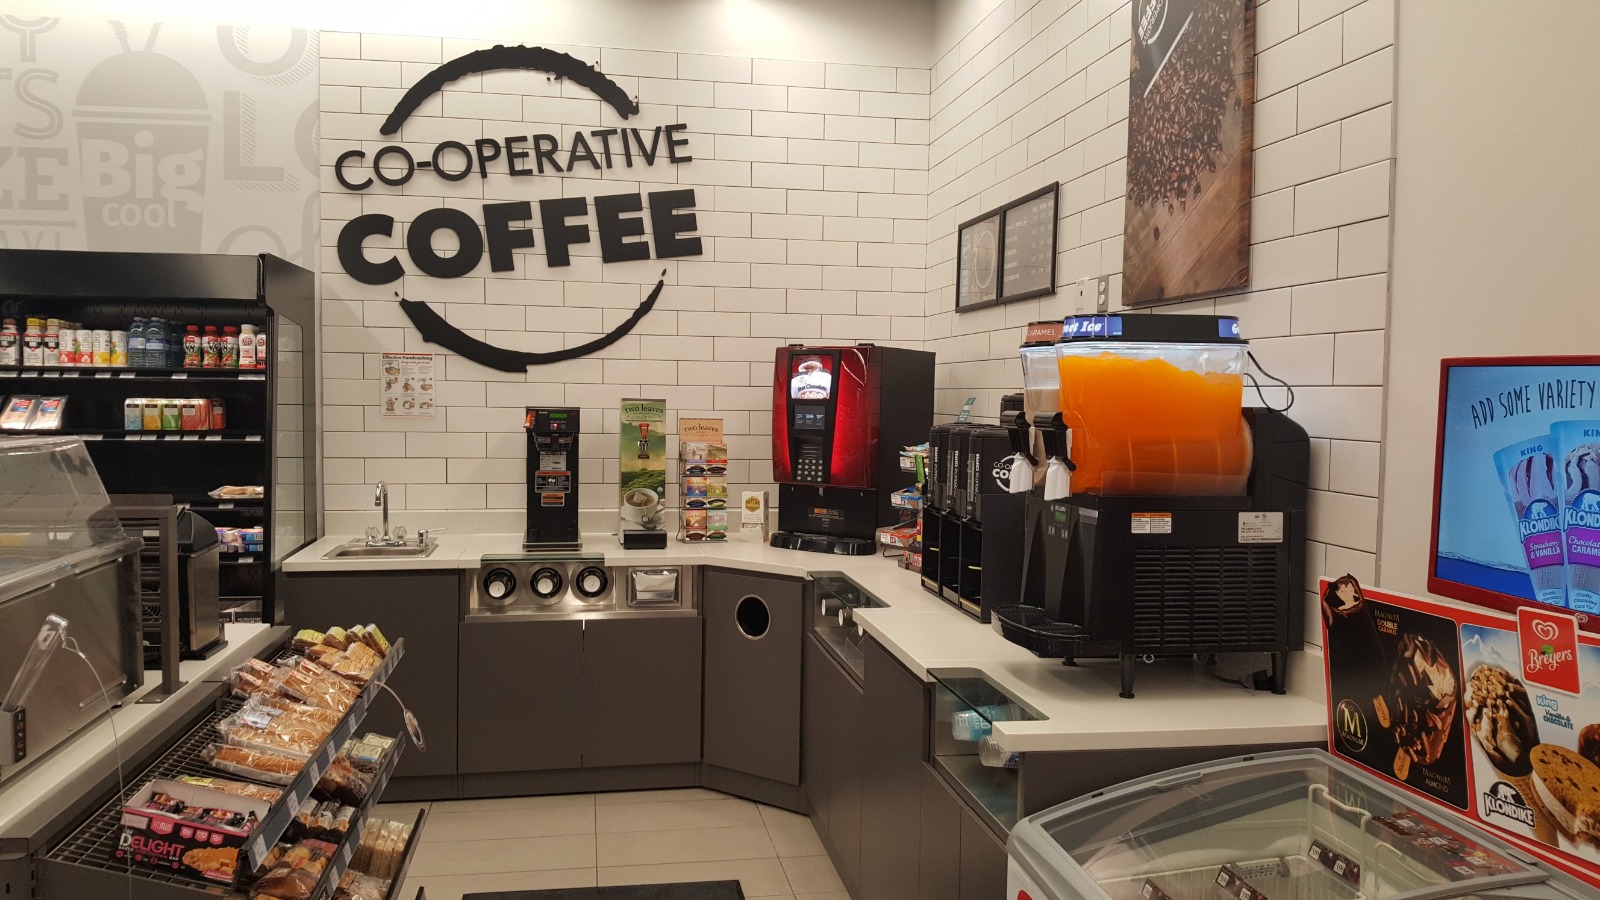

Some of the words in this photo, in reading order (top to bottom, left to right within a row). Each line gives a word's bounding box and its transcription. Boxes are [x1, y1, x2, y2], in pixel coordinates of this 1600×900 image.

[335, 123, 693, 191] CO-OPERATIVE
[81, 130, 206, 214] Big
[102, 199, 177, 228] cool
[337, 188, 703, 285] COFFEE
[1027, 328, 1057, 337] CARAMEL
[1080, 321, 1102, 332] Ice
[642, 404, 664, 414] leaves
[1471, 397, 1494, 430] ADD
[1499, 385, 1531, 418] SOME
[1538, 379, 1596, 411] VARIETY
[699, 423, 719, 433] leaves
[1583, 429, 1600, 438] KIN
[1520, 445, 1544, 457] KING
[1564, 508, 1600, 532] KLOND
[1520, 515, 1560, 542] KLONDIK
[1569, 536, 1600, 547] Chocolat
[1536, 547, 1561, 558] VANILLA
[1572, 545, 1600, 557] CARAME
[1374, 609, 1400, 622] MAGNUM
[1376, 618, 1398, 630] DOUBLE
[1378, 625, 1397, 635] CARAMEL
[1526, 648, 1573, 673] Breyers
[1536, 694, 1558, 711] King
[1543, 714, 1574, 730] CHOCOLATE
[1484, 792, 1535, 827] KLONDIKE
[119, 833, 185, 858] DELIGHT
